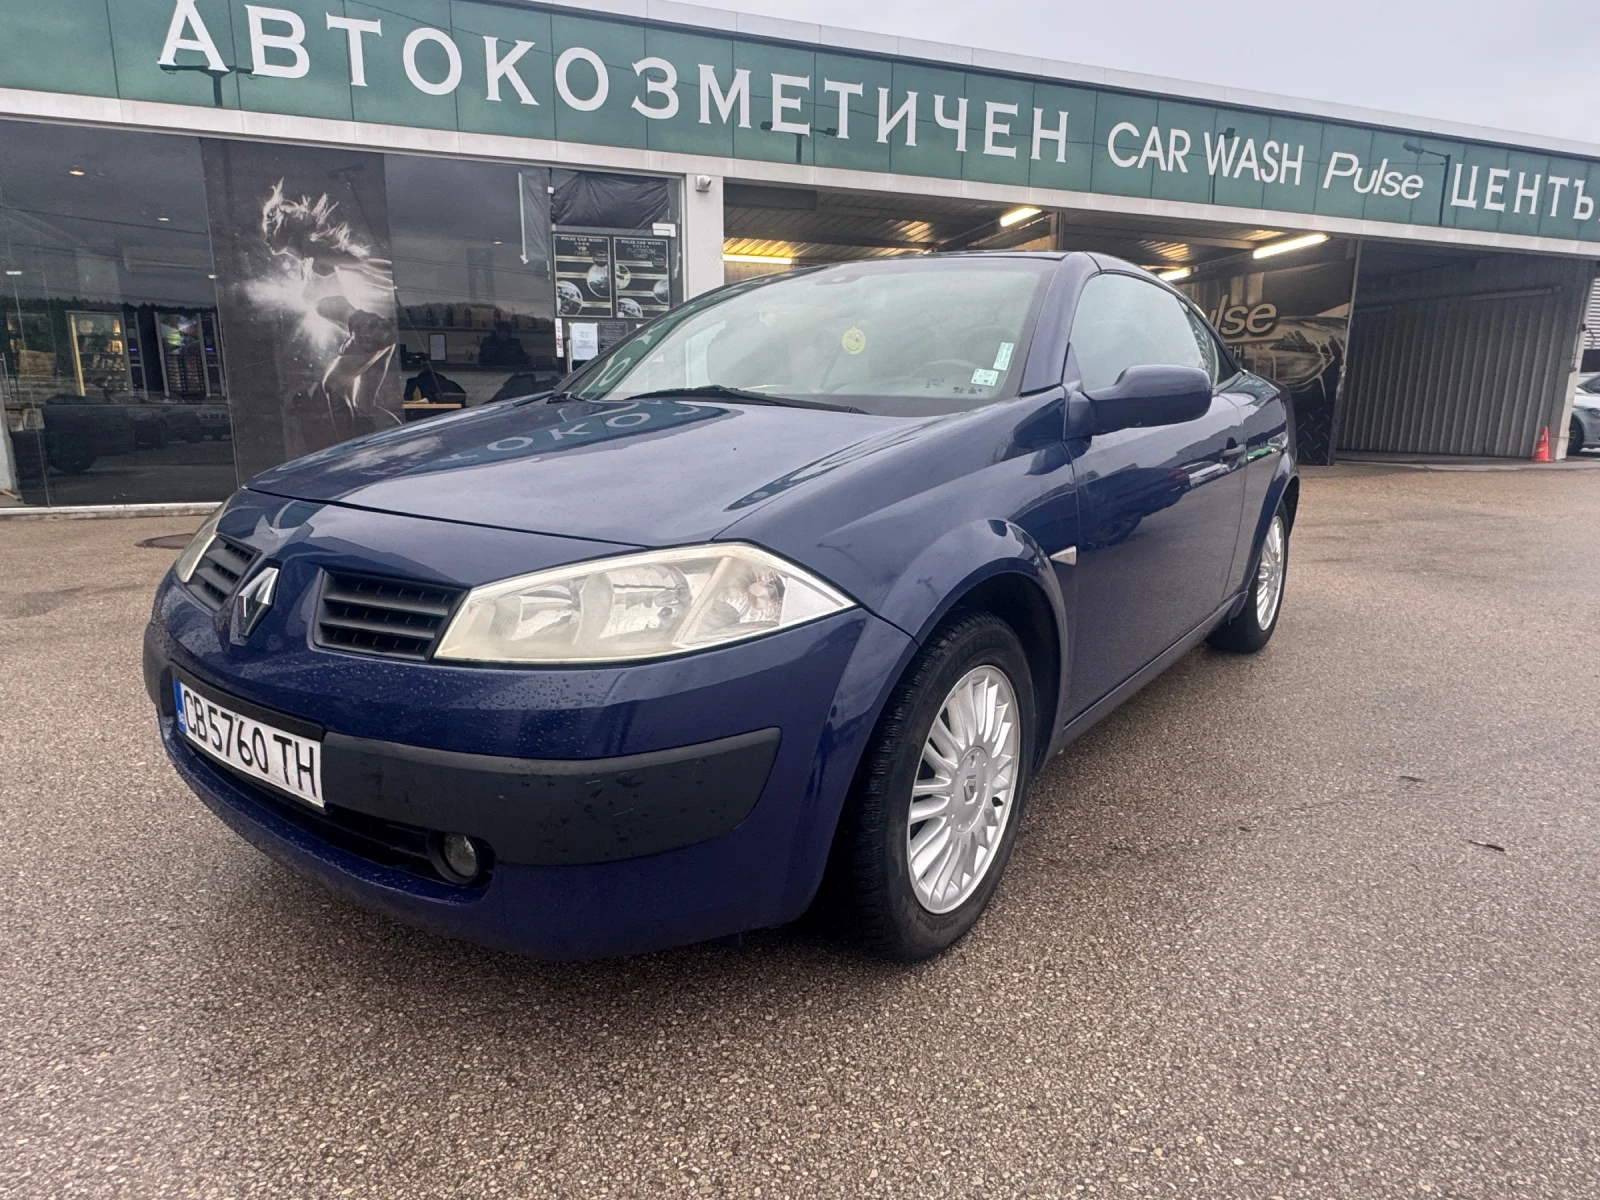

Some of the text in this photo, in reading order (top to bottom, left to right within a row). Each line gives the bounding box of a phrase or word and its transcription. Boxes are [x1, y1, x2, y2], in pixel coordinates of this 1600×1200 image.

[157, 0, 1069, 163] АВТОКОЗМЕТИЧЕН
[1107, 122, 1304, 185] CAR WASH
[1322, 152, 1424, 200] Pulse
[1450, 163, 1600, 222] ЦЕНТЪ
[1209, 294, 1277, 334] lse
[273, 733, 317, 798] TH
